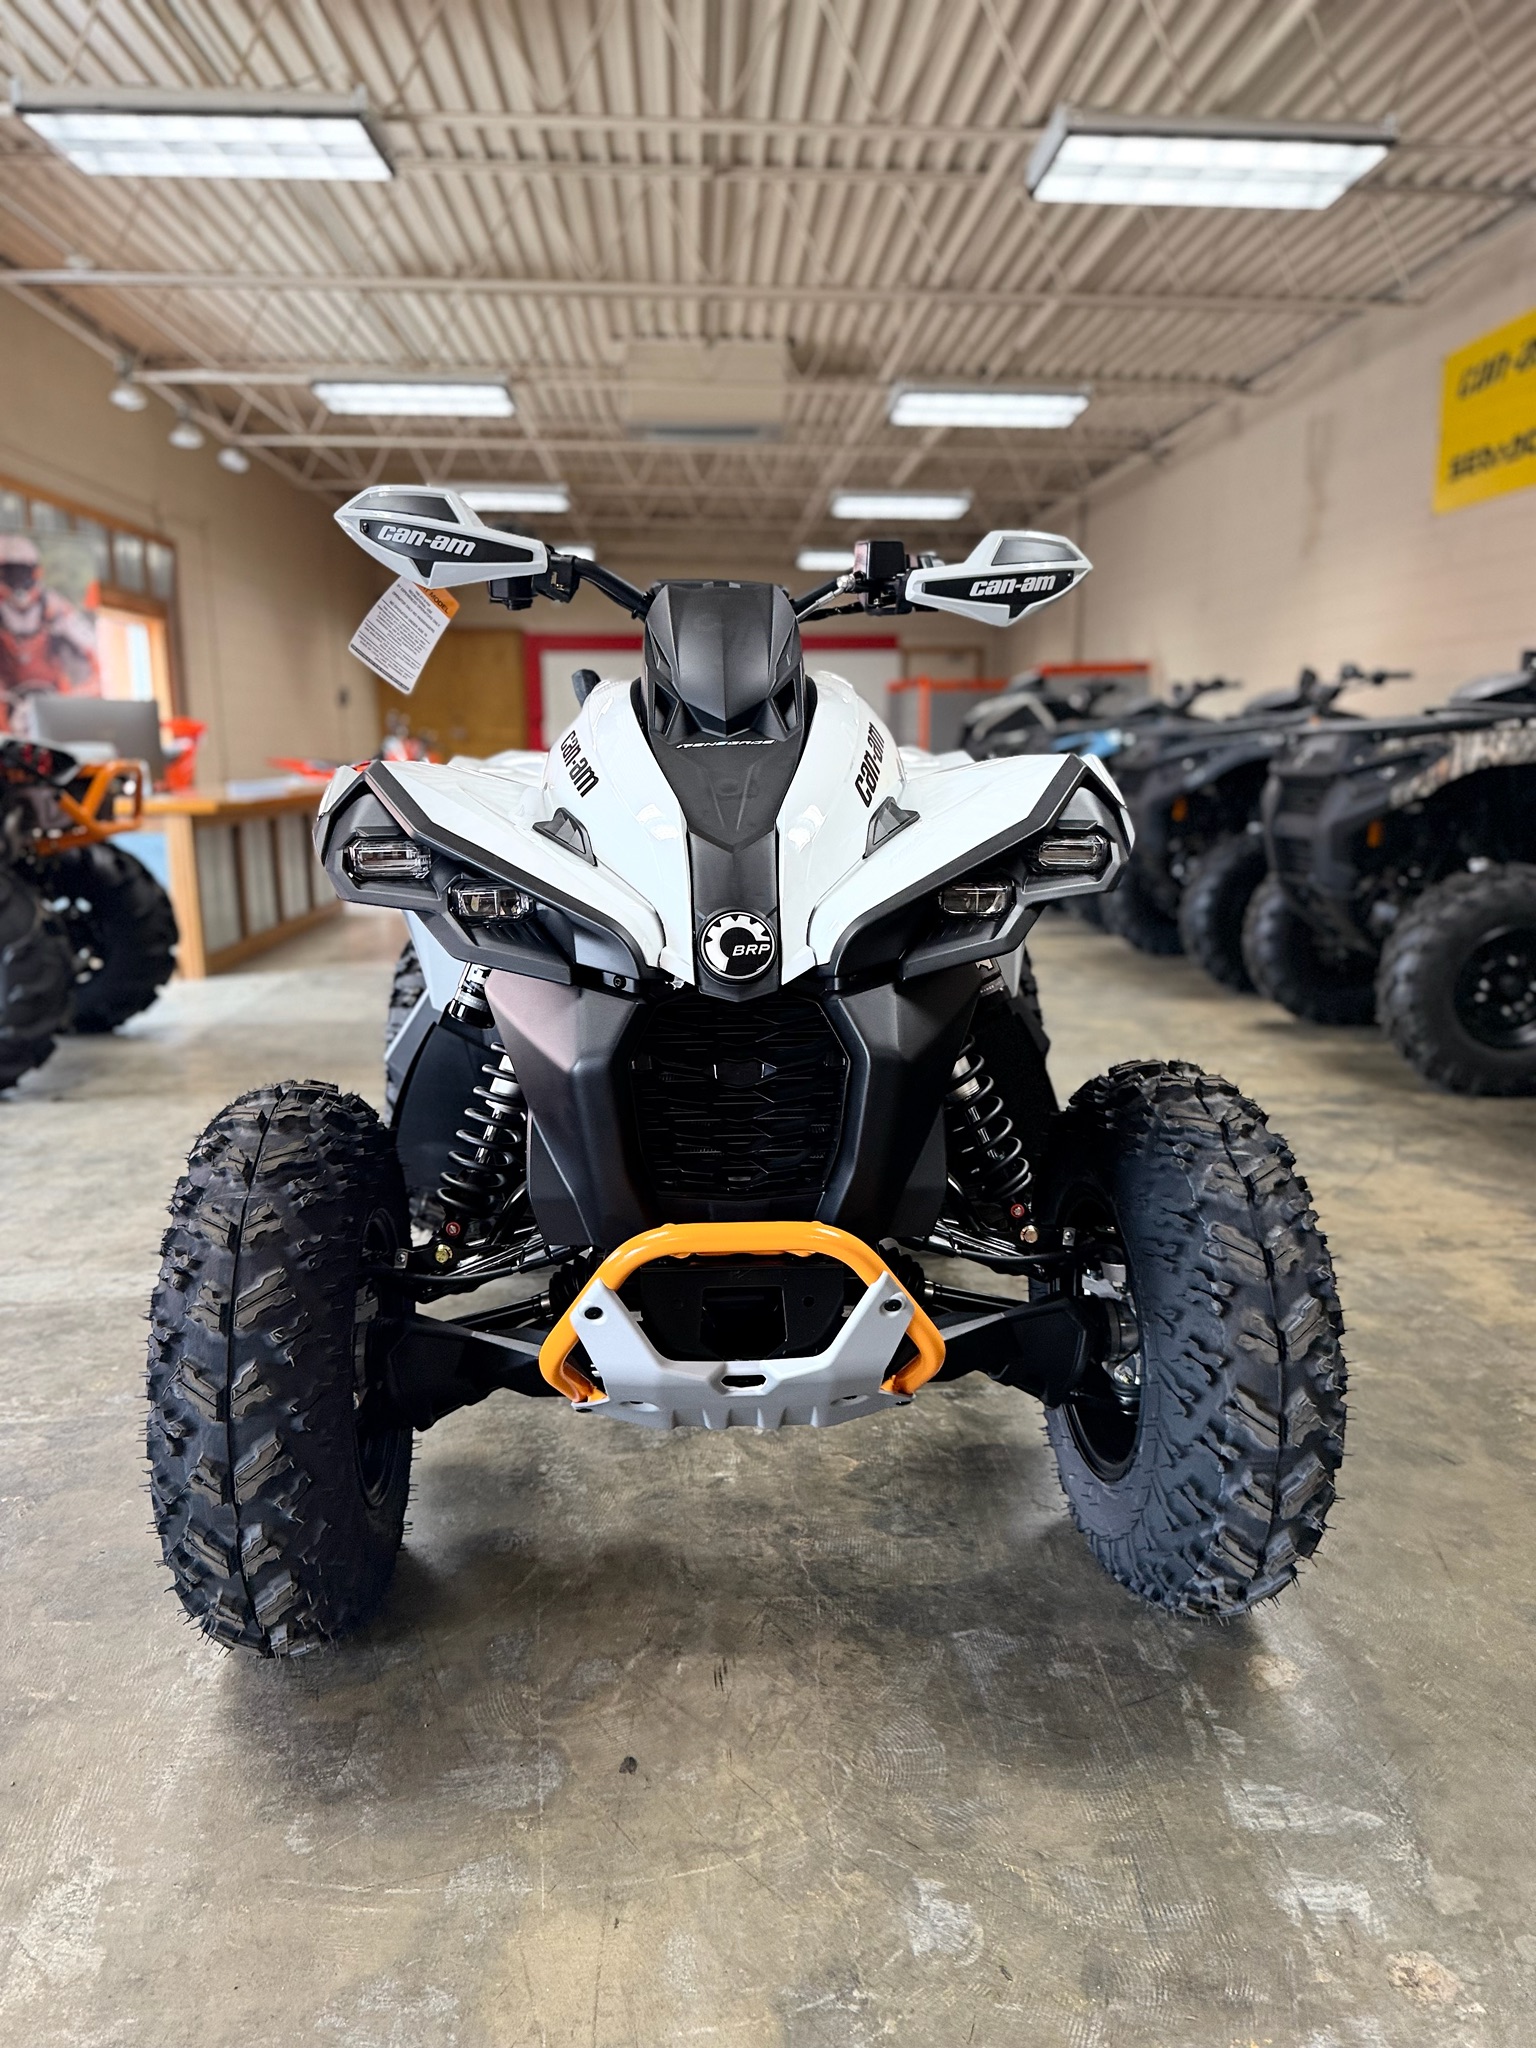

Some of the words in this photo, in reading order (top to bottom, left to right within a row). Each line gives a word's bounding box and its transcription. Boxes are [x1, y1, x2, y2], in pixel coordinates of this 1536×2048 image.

[378, 525, 476, 557] can-am
[969, 575, 1056, 597] can-am
[428, 592, 450, 614] MODEL
[561, 730, 599, 798] can-am
[855, 721, 884, 808] can-am
[732, 943, 770, 957] BRP
